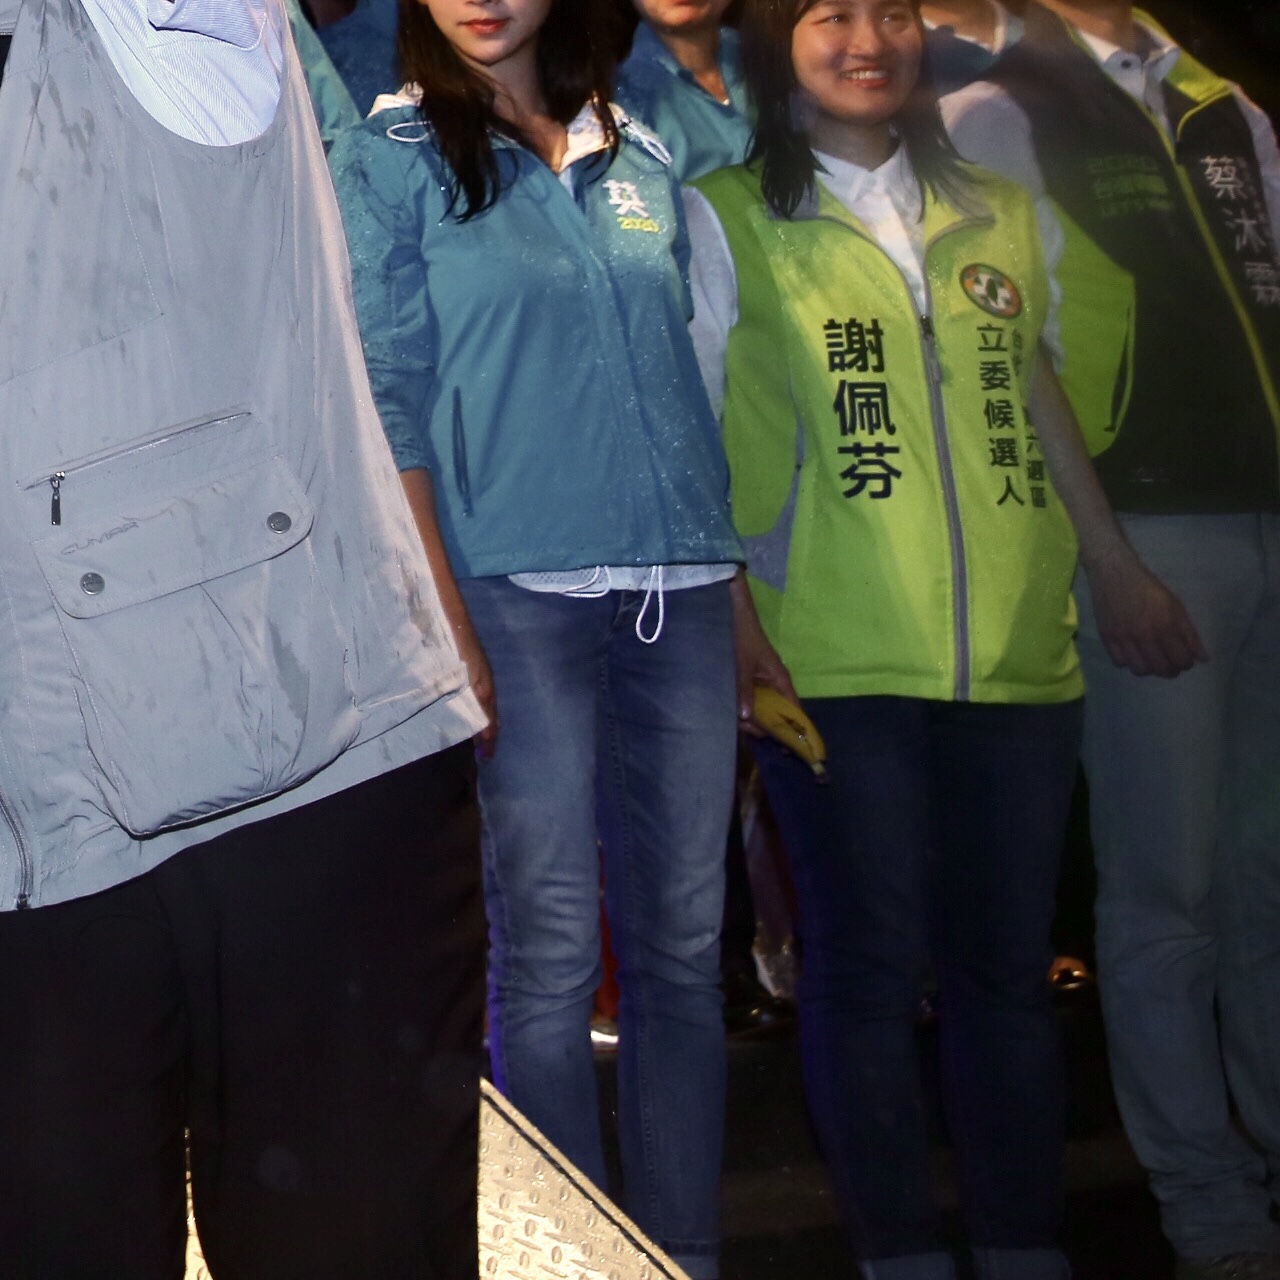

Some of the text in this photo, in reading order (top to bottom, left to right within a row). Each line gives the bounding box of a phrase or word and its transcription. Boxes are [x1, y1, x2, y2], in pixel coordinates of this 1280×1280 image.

[823, 317, 902, 501] 謝佩芬
[976, 322, 1025, 507] 立委候選人
